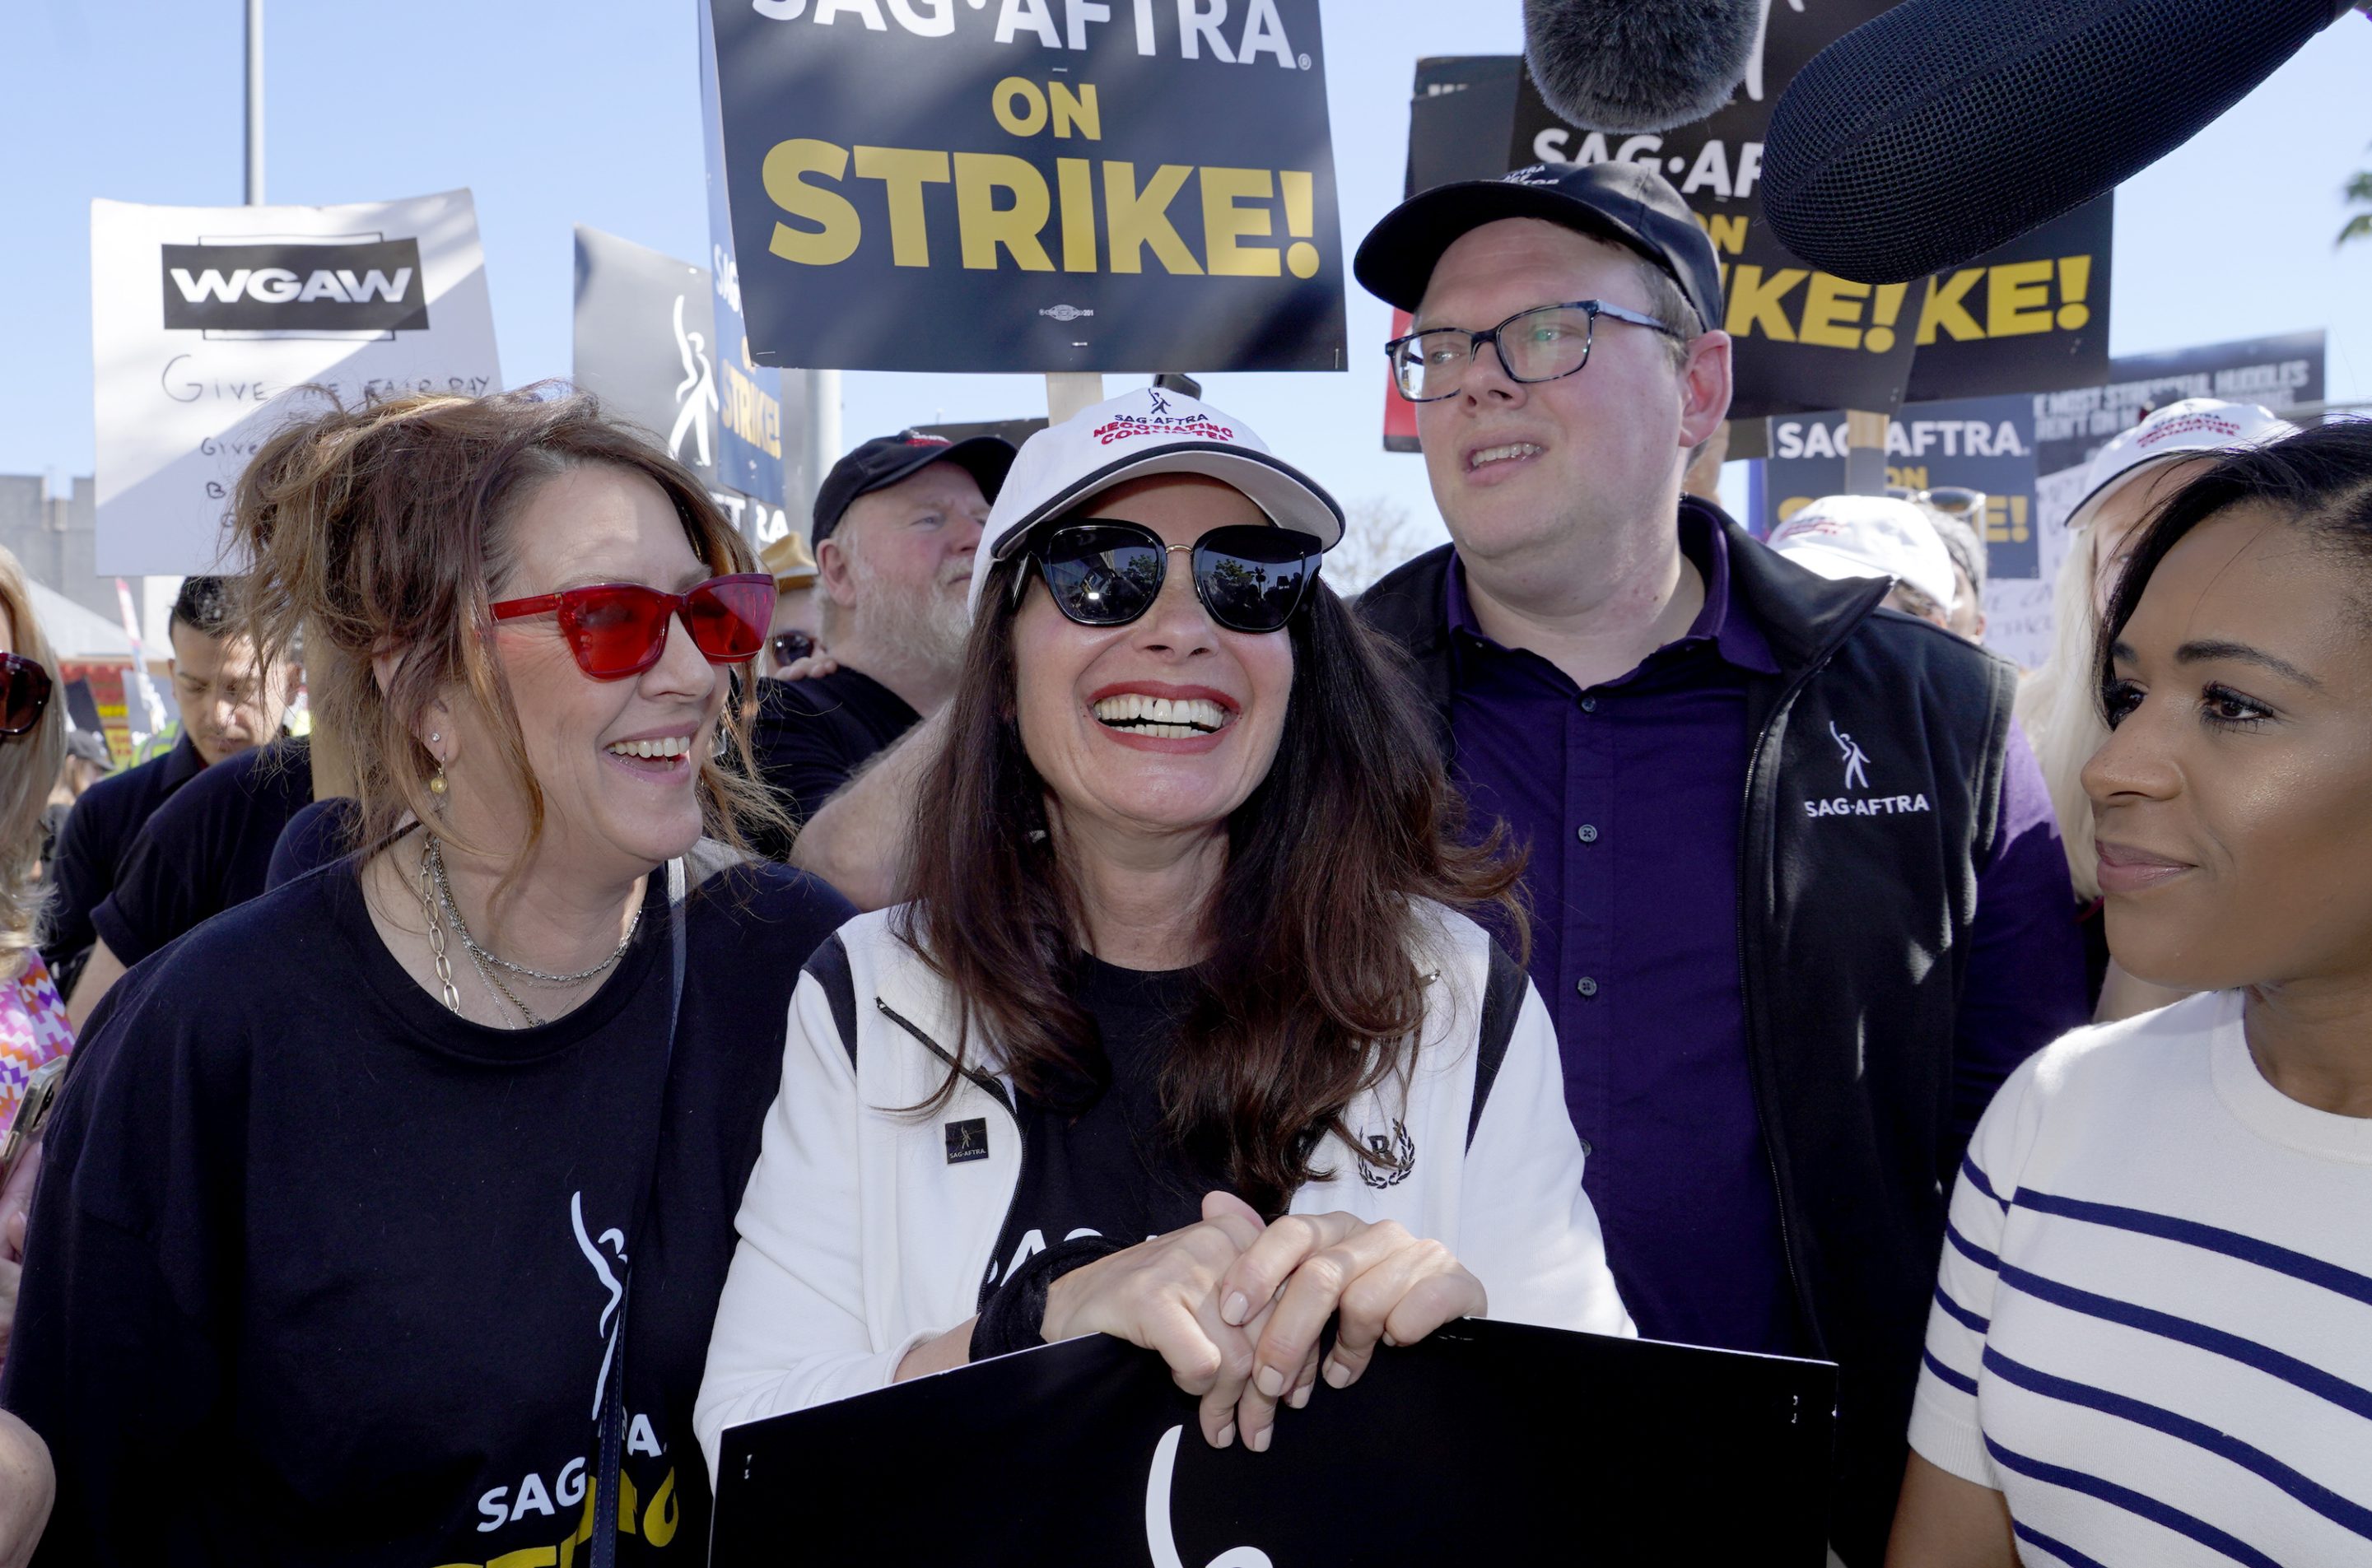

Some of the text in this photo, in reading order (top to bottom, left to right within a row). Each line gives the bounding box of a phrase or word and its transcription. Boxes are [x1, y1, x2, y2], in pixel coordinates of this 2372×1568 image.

[992, 76, 1102, 141] ON
[762, 137, 1321, 280] STRIKE!
[1694, 212, 1749, 255] N
[170, 268, 412, 303] WGAW
[722, 359, 781, 460] STRIKE!
[1804, 793, 1930, 817] SAG·AFTRA
